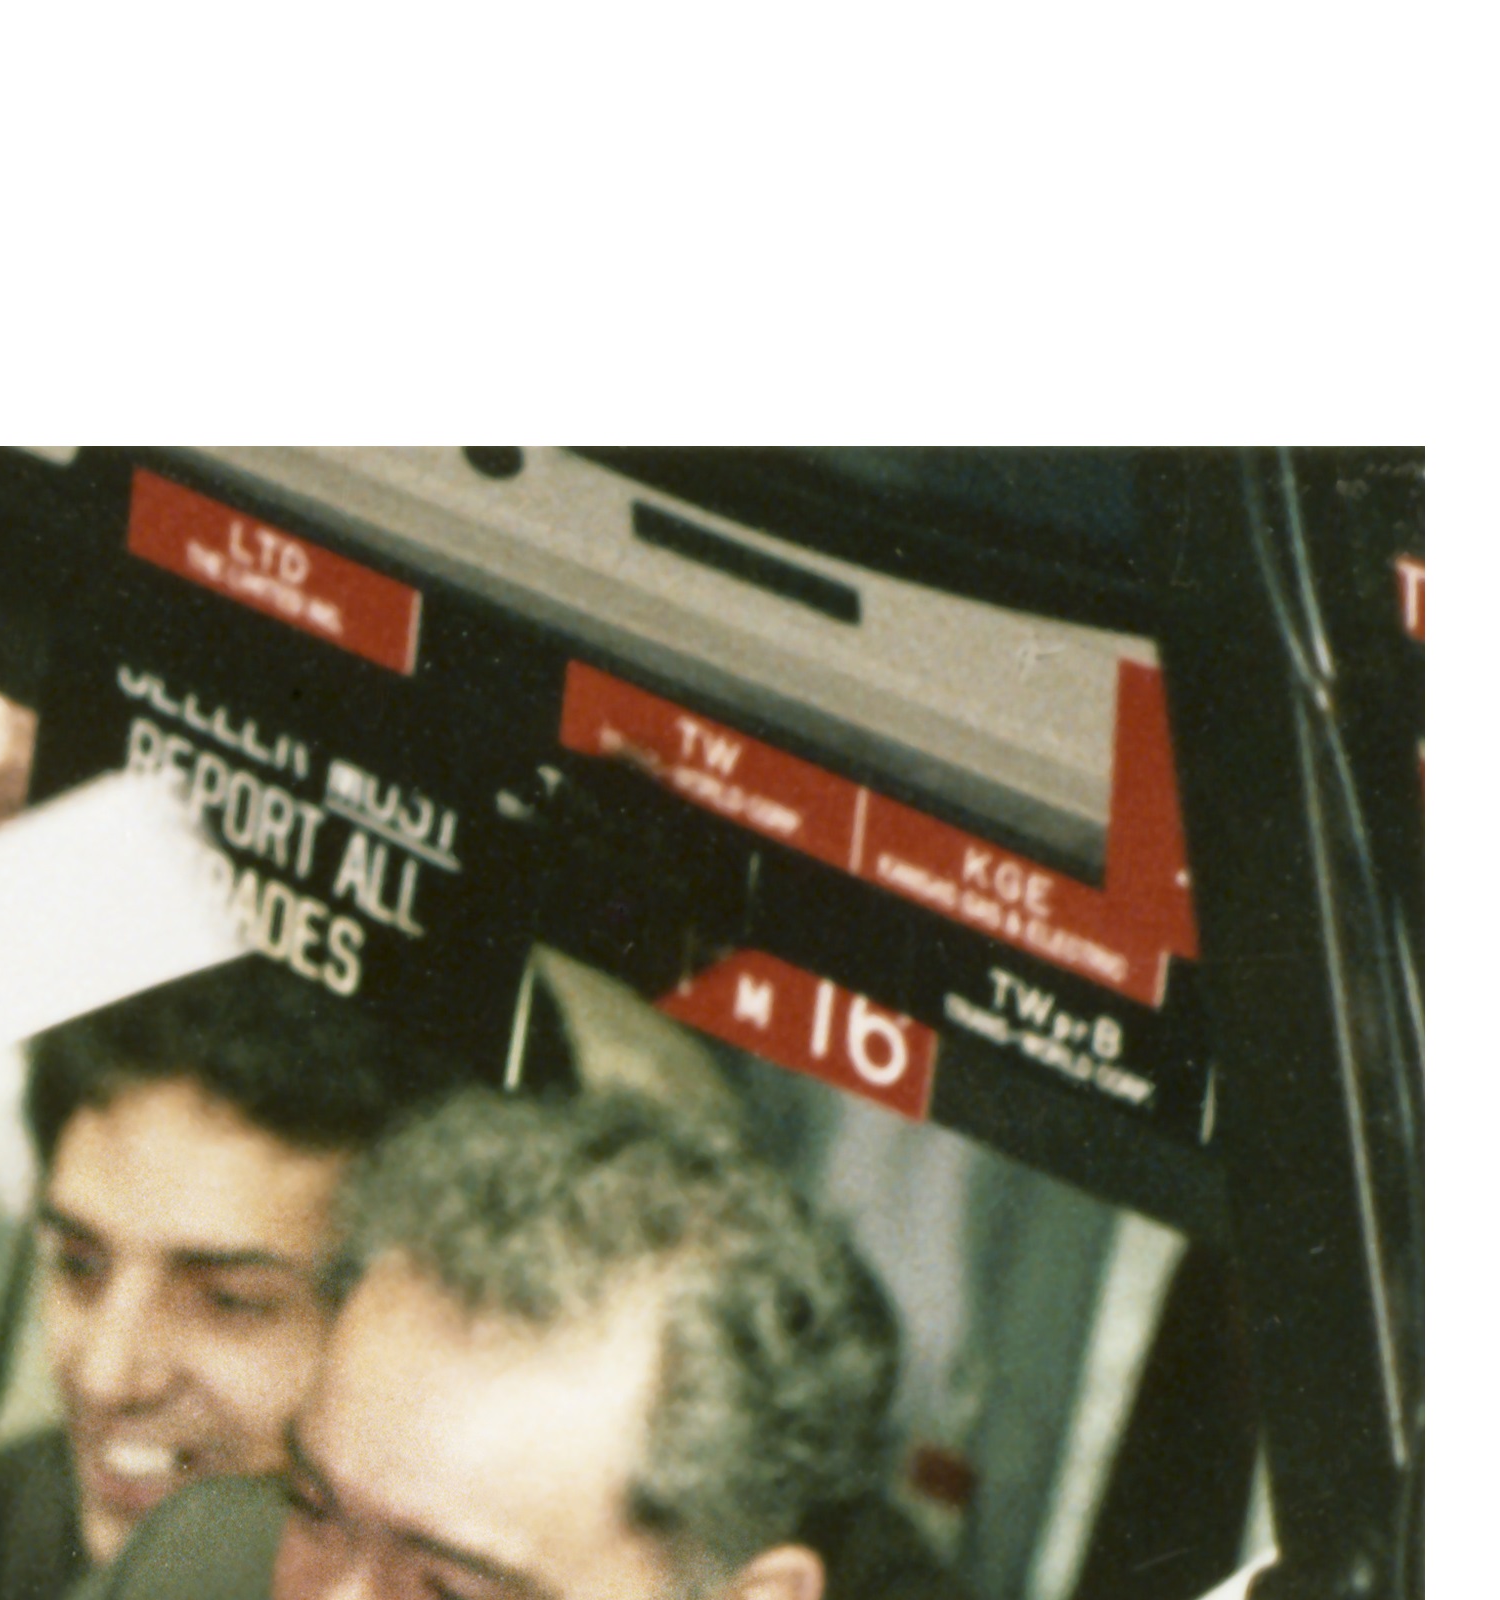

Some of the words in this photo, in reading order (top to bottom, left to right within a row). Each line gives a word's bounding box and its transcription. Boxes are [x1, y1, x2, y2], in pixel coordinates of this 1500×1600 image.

[229, 519, 311, 585] LTD
[676, 715, 742, 778] TW
[127, 717, 326, 880] REPORT
[332, 831, 426, 940] ALL
[199, 848, 366, 997] RADES
[962, 846, 1054, 918] KGE
[809, 977, 909, 1087] 16
